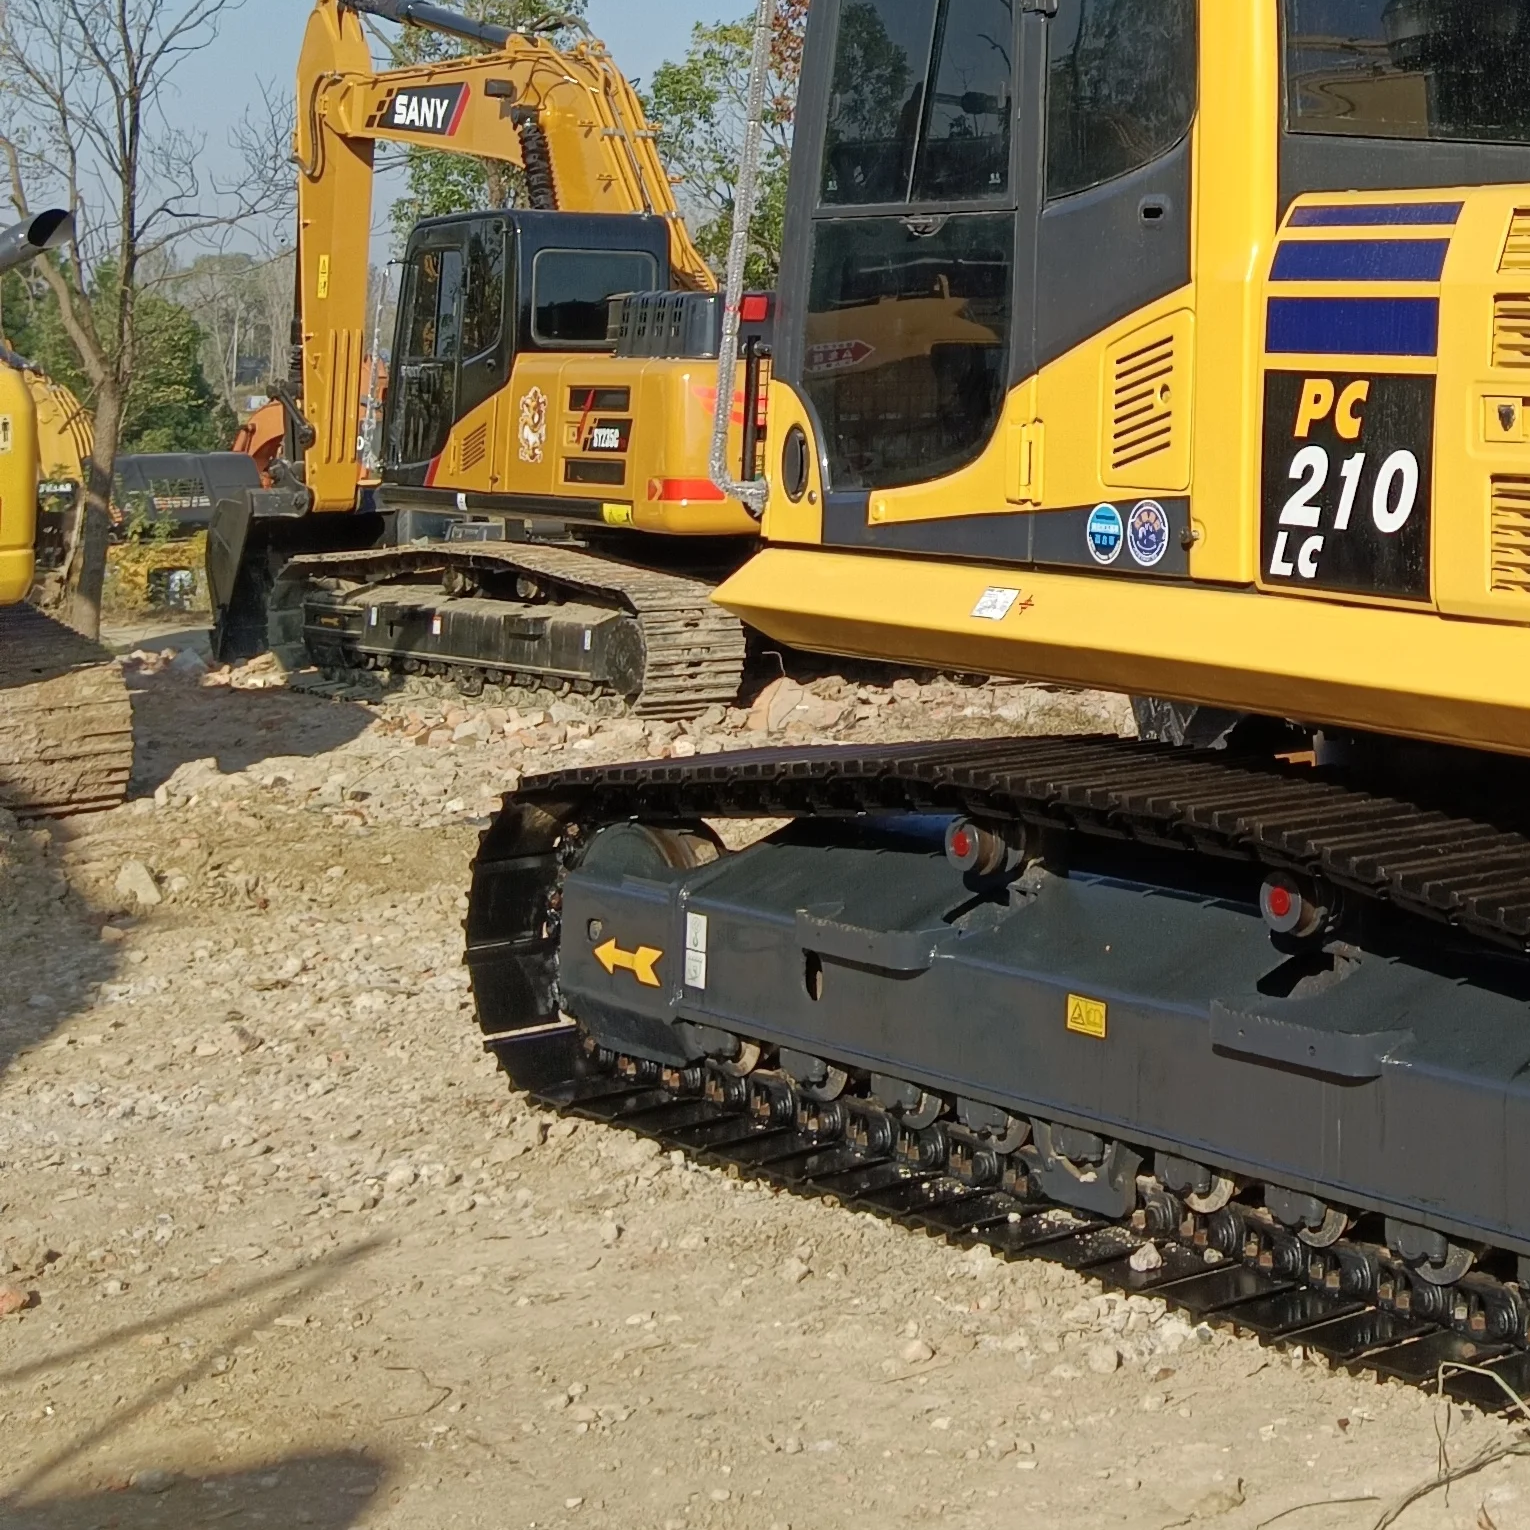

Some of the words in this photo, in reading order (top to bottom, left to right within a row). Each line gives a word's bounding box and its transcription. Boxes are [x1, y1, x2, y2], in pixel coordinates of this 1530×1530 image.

[394, 94, 449, 129] SANY
[1294, 378, 1370, 438] PC
[1278, 445, 1419, 533] 210
[1270, 531, 1324, 579] LC
